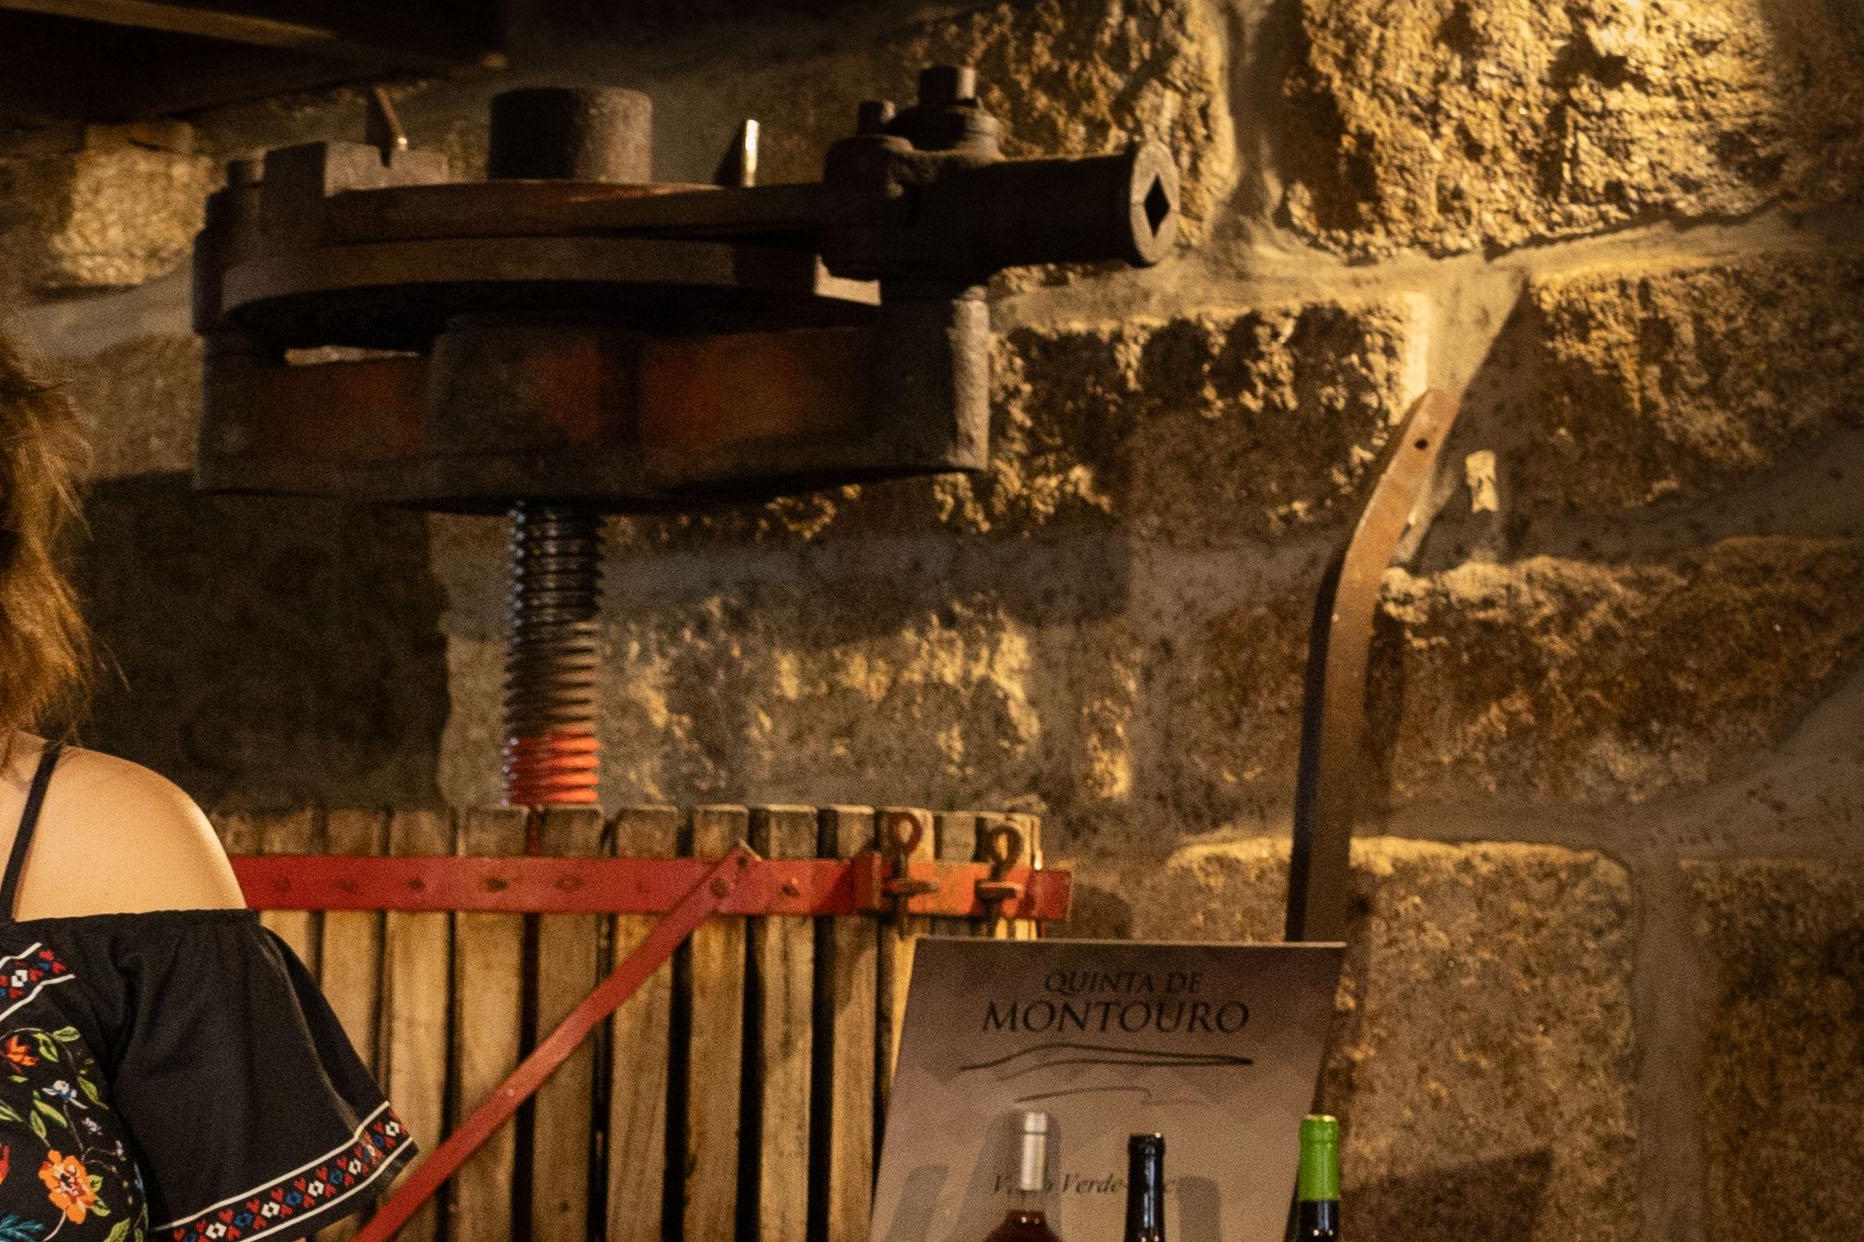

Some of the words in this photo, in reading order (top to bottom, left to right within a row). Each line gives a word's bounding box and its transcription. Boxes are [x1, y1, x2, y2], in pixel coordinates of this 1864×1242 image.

[1044, 970, 1154, 995] QUINTA
[1165, 971, 1203, 994] DE
[981, 1000, 1251, 1034] MONTOURO
